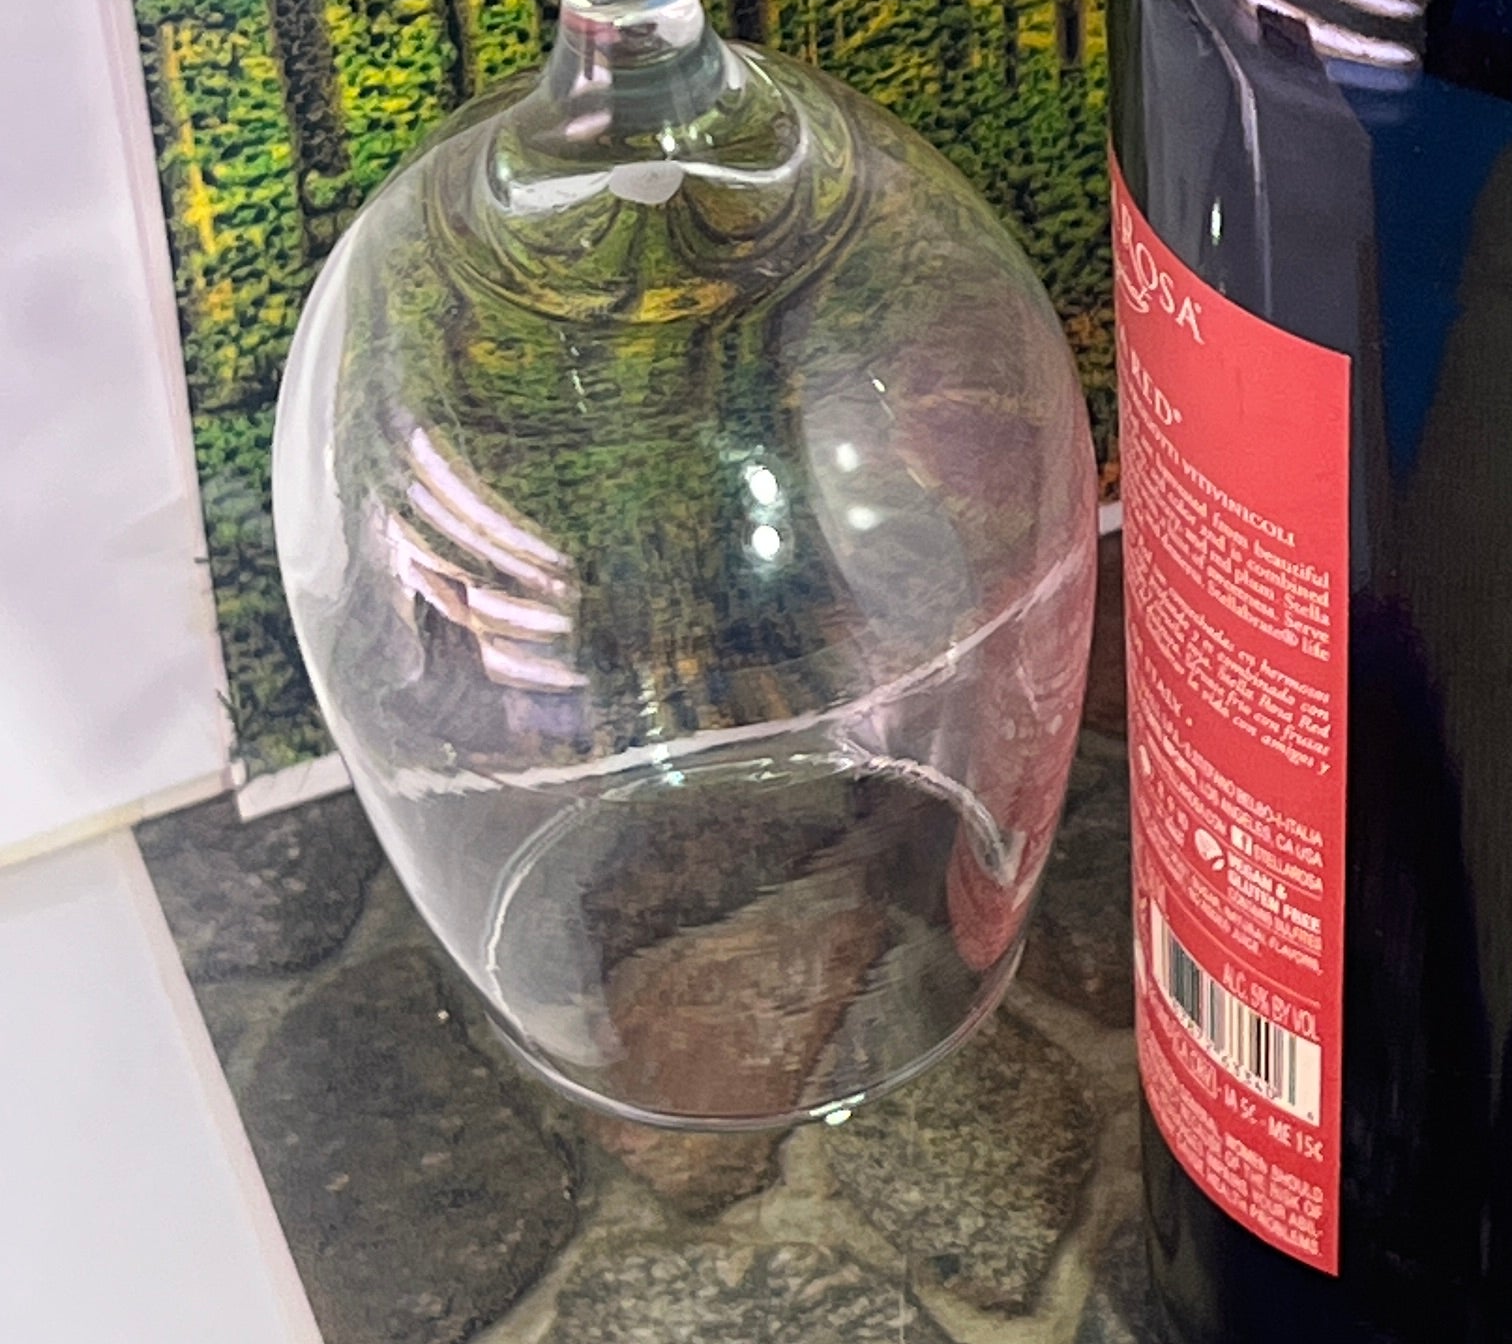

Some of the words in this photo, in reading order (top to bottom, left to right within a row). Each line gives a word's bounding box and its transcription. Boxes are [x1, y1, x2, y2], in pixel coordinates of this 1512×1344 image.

[1119, 202, 1205, 346] ROSA
[1130, 351, 1172, 426] RED
[1245, 556, 1330, 605] combined
[1252, 540, 1330, 587] beautiful
[1282, 594, 1331, 625] Stella
[1283, 611, 1330, 643] Serve
[1300, 636, 1330, 661] life
[1227, 853, 1273, 891] VEGAN
[1275, 881, 1288, 902] &
[1227, 870, 1280, 913] GLUTEN
[1282, 904, 1322, 933] FREE
